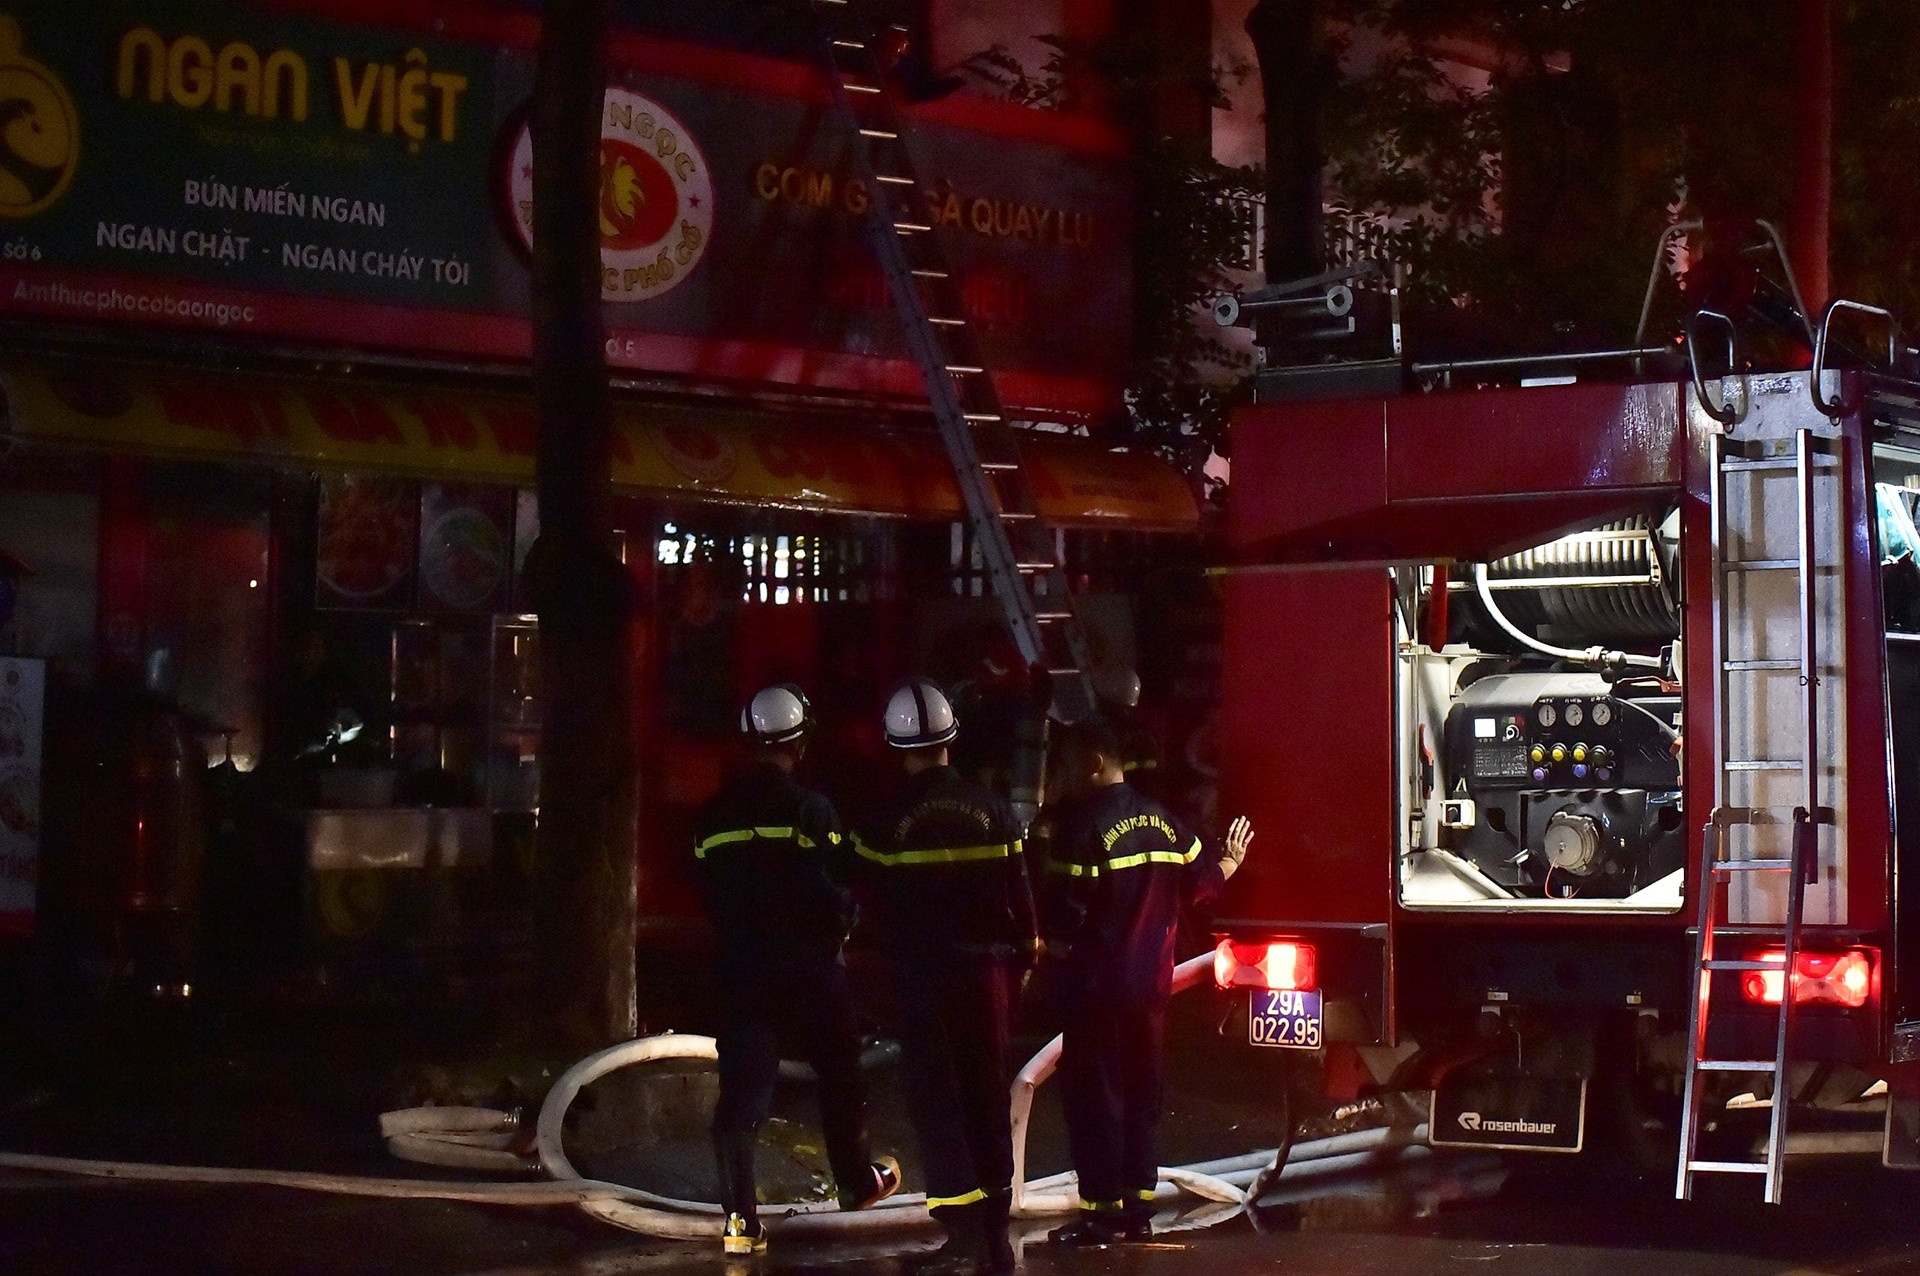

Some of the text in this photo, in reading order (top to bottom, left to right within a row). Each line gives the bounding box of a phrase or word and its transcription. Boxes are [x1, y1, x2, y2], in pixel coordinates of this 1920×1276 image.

[118, 28, 308, 122] NGAN
[335, 47, 468, 153] VIỆT
[610, 102, 696, 182] NGỌC
[185, 174, 385, 227] BÚN MIẾN NGAN
[971, 196, 1050, 242] QUAY
[31, 245, 43, 262] 6
[96, 221, 176, 255] NGAN
[182, 227, 251, 267] CHẶT
[281, 243, 357, 275] NGAN
[360, 247, 424, 281] CHÁY
[13, 279, 255, 326] Amthucphocobaongoc
[626, 340, 635, 358] 5
[1267, 989, 1305, 1017] 29A
[1252, 1015, 1319, 1046] 022.95
[1482, 1117, 1557, 1135] rosenbauer
